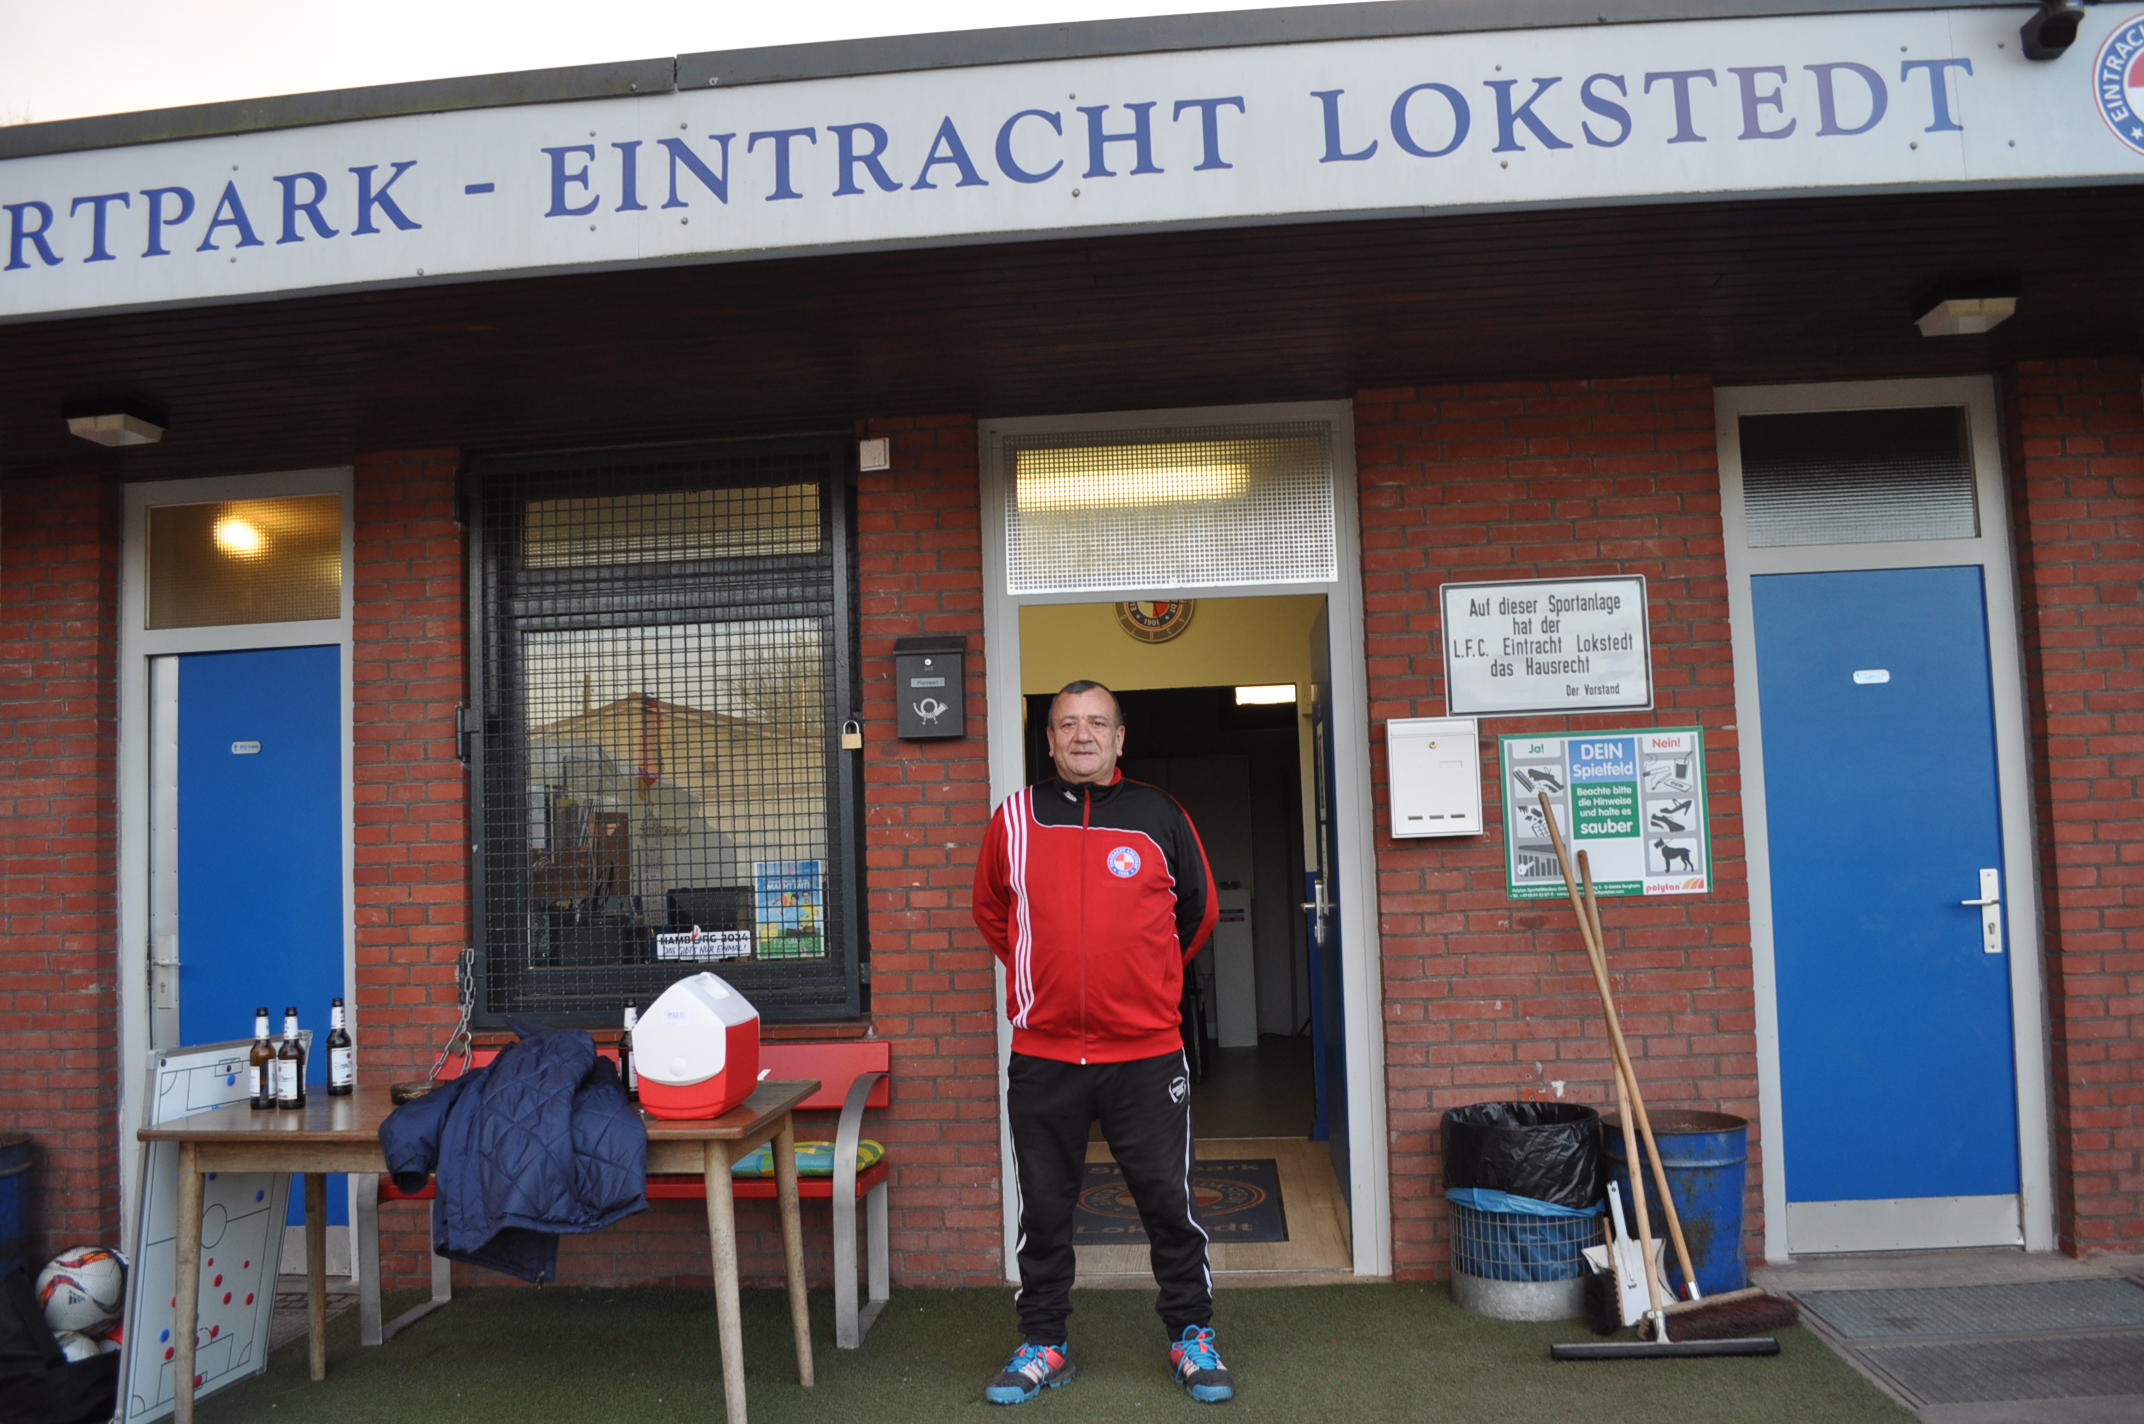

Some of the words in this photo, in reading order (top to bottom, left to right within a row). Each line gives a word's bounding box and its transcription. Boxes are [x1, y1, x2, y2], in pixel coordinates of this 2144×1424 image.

[3, 160, 422, 271] RTPARK
[541, 95, 1246, 218] EINTRACHT
[1310, 57, 1974, 165] LOKSTEDT
[1469, 597, 1490, 617] Auf
[1499, 597, 1538, 616] dieser
[1548, 592, 1621, 617] Sportanlage
[1513, 617, 1532, 635] hat
[1541, 616, 1560, 634] der
[1453, 639, 1489, 658] L.F.C.
[1503, 636, 1562, 656] Eintracht
[1577, 632, 1633, 652] Lokstedt
[1490, 659, 1514, 677] das
[1526, 656, 1590, 676] Hausrecht
[1566, 685, 1579, 697] Der
[1584, 682, 1620, 696] Vorstand
[1528, 743, 1544, 755] Ja!
[1652, 738, 1681, 749] Nein!
[1581, 743, 1623, 760] DEIN
[1573, 761, 1634, 781] Spielfeld
[1577, 787, 1611, 796] Beachte
[1613, 785, 1632, 795] bitte
[1578, 798, 1592, 807] die
[1593, 796, 1632, 806] Hinweise
[1580, 808, 1597, 817] und
[1599, 807, 1619, 816] halte
[1621, 808, 1632, 816] es
[1580, 819, 1633, 834] sauber
[1646, 881, 1681, 894] polytan
